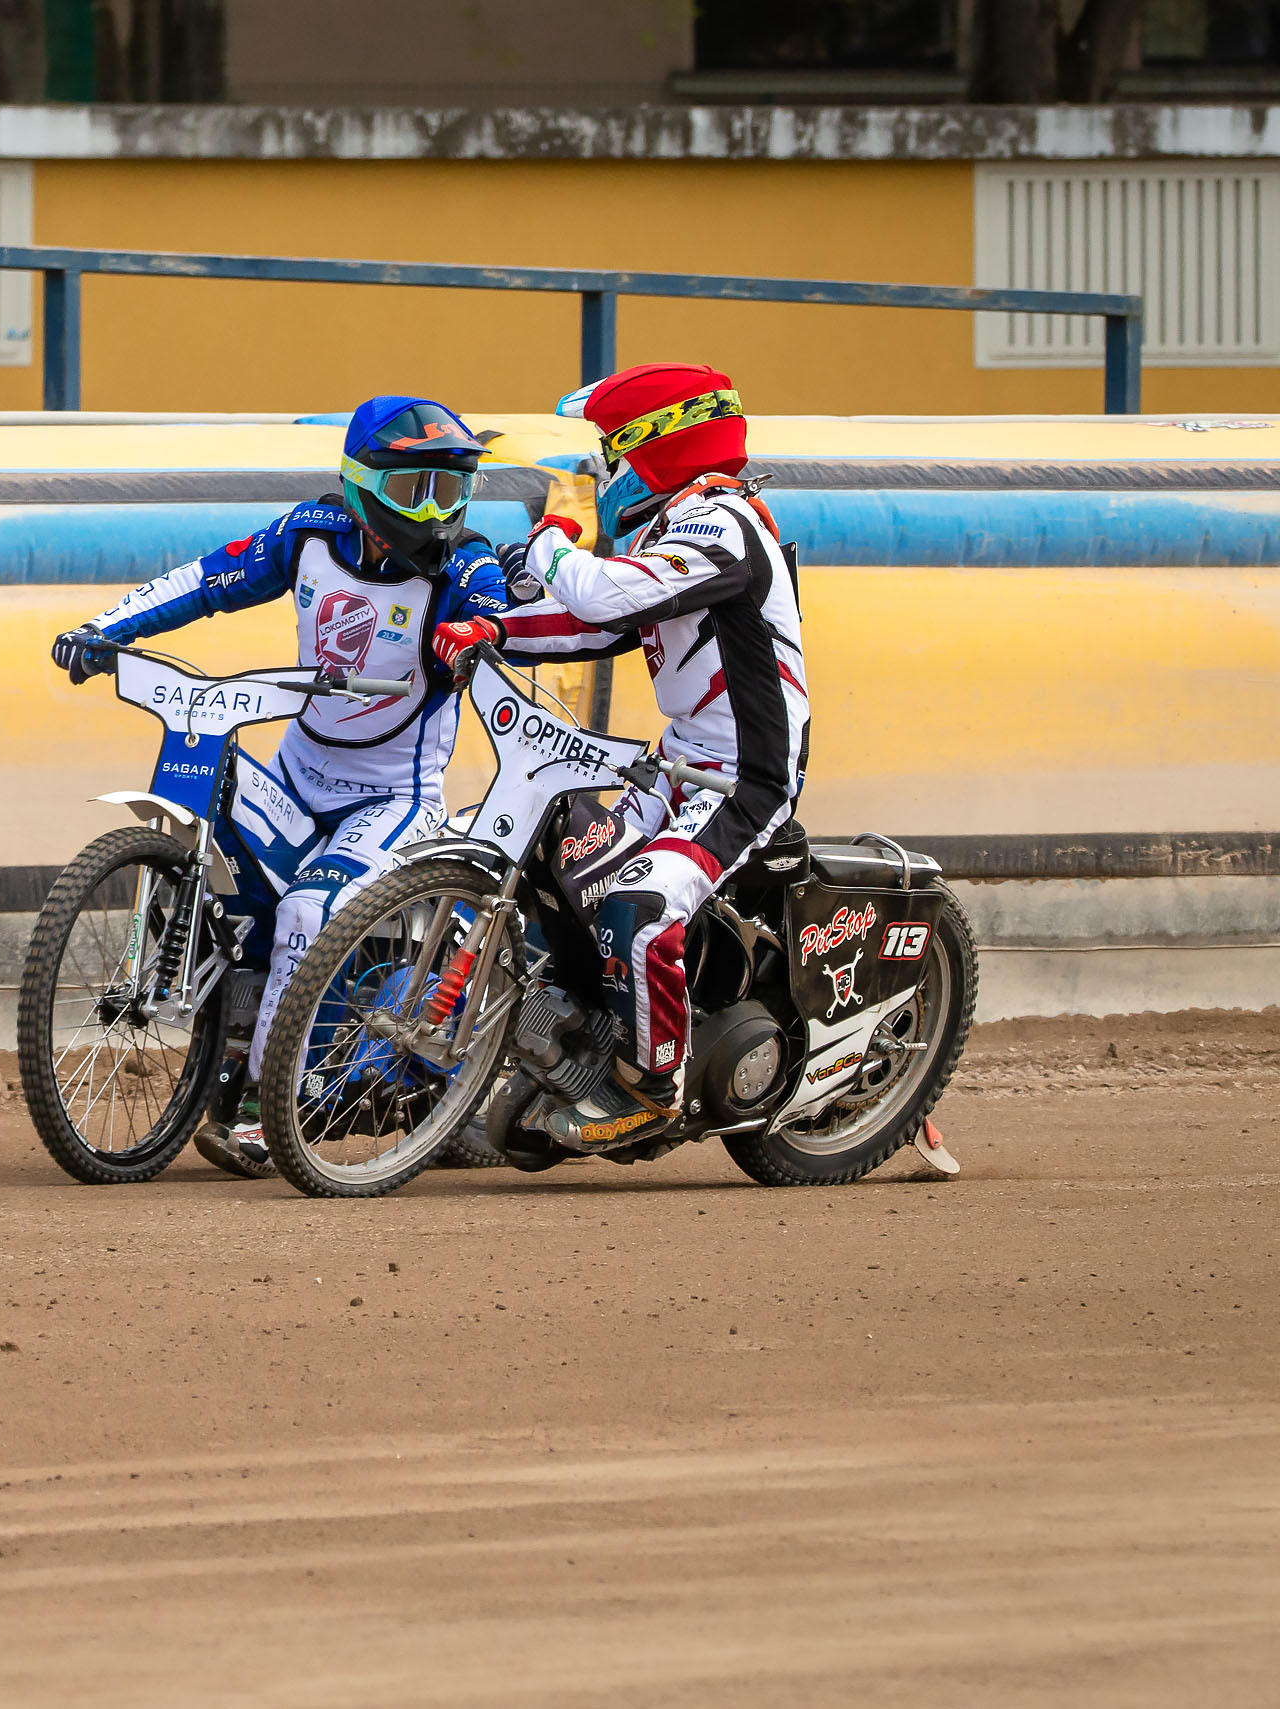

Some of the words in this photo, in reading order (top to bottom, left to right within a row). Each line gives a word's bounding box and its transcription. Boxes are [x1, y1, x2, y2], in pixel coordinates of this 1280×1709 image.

[669, 523, 727, 539] winner
[320, 608, 370, 637] LOKOMOTIV
[152, 685, 262, 714] SAGARI
[175, 709, 224, 721] SPORTS
[522, 714, 610, 773] OPTIBET
[162, 762, 215, 777] SAGARI
[251, 771, 295, 825] SAGARI
[883, 927, 928, 957] 113
